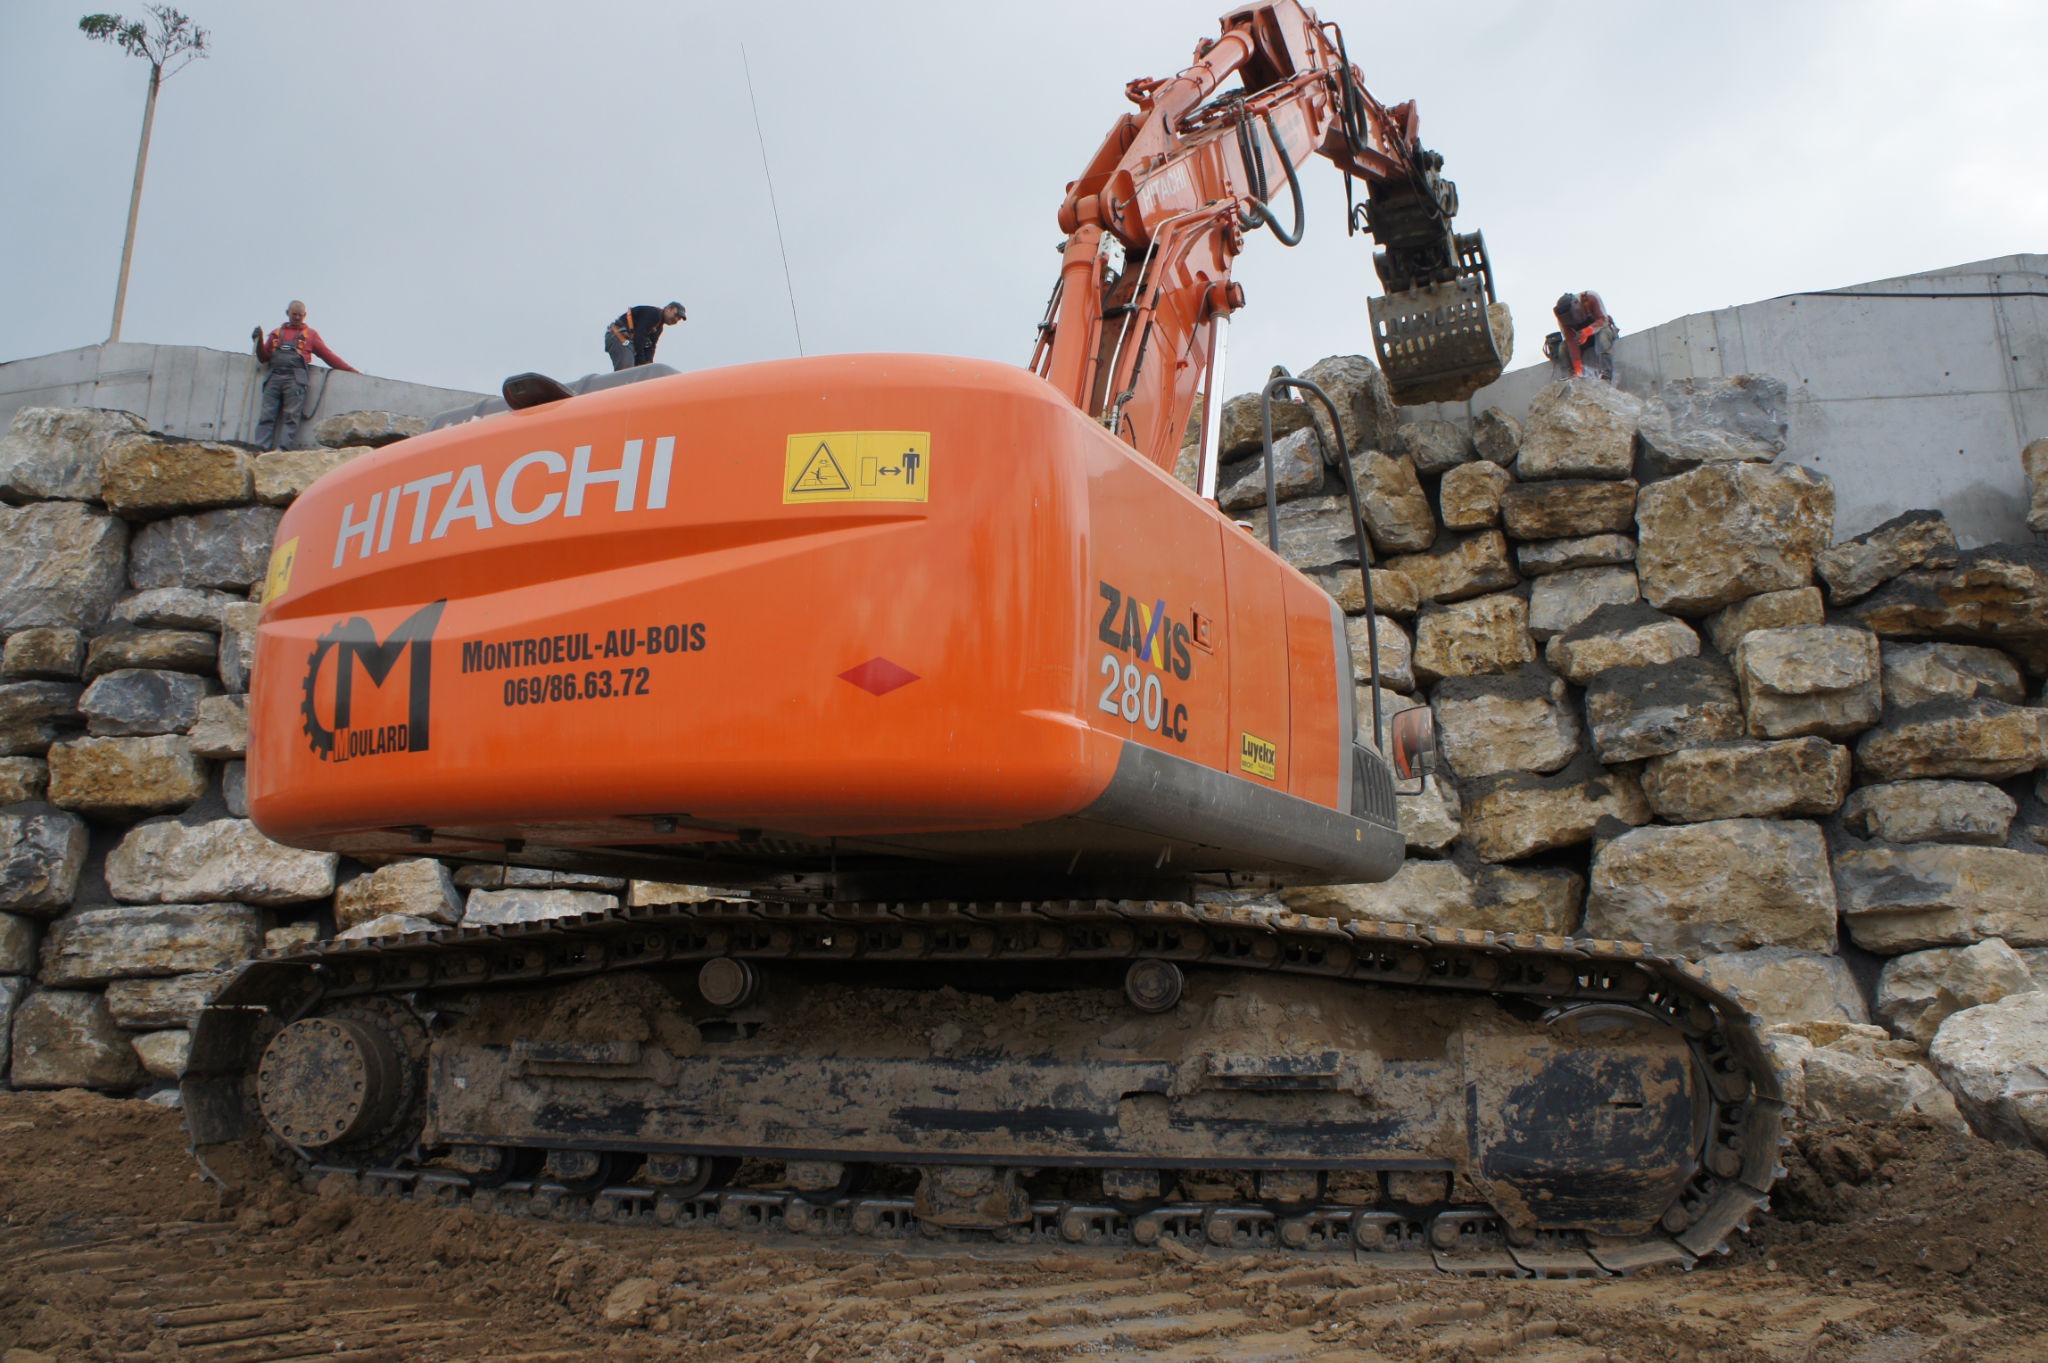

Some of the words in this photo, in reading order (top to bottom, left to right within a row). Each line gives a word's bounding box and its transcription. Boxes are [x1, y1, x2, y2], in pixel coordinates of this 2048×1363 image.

[1141, 166, 1187, 210] HITACHI
[332, 436, 677, 569] HITACHI
[462, 622, 707, 674] MONTROEUL-AU-BOIS
[1098, 580, 1191, 681] ZAXIS
[503, 667, 651, 707] 069/86.63.72
[332, 723, 408, 763] MOULARD
